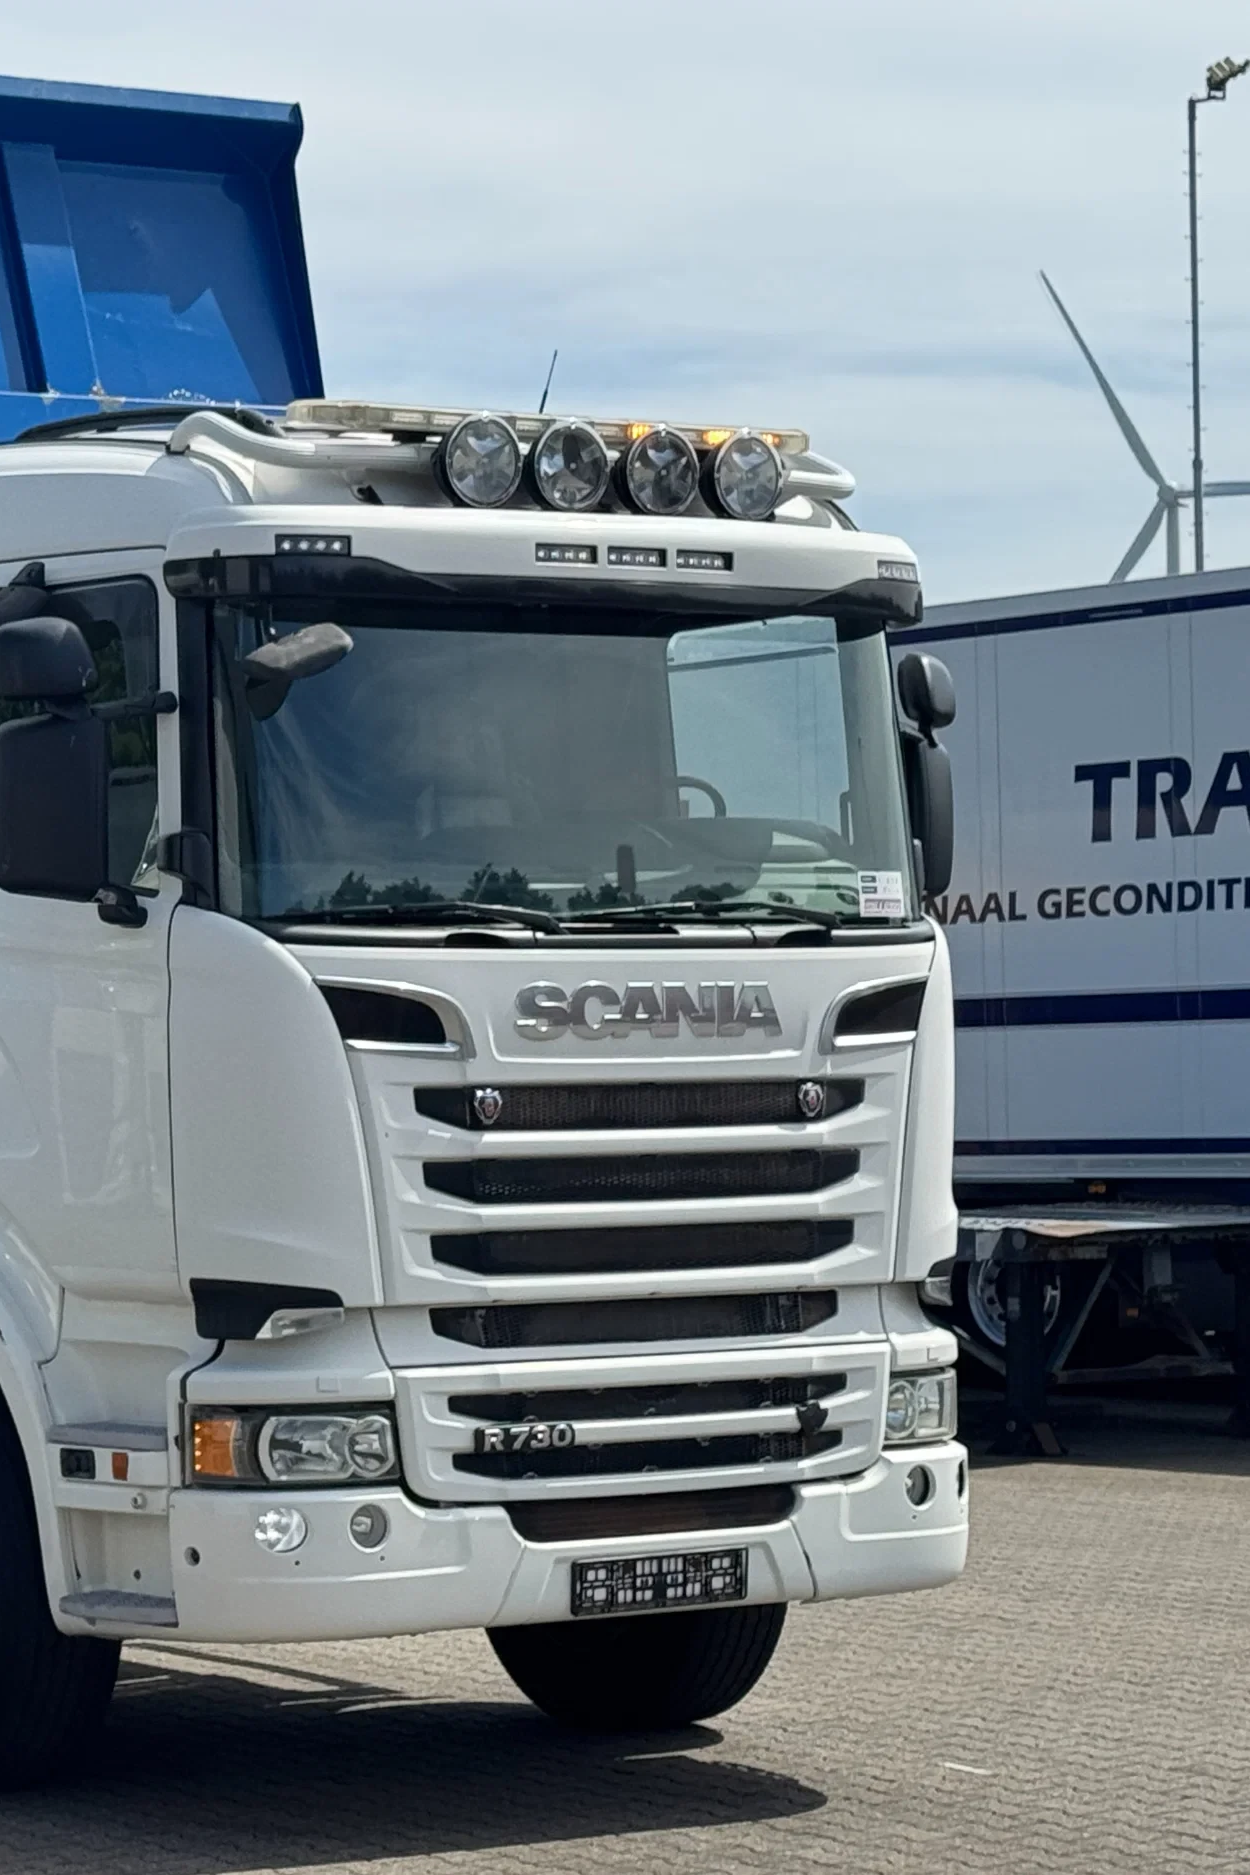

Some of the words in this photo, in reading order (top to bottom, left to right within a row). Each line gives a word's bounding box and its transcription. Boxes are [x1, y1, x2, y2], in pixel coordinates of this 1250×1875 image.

[1074, 751, 1250, 843] TRA
[514, 980, 783, 1041] SCANIA
[483, 1428, 505, 1452] R
[510, 1424, 573, 1450] 730
